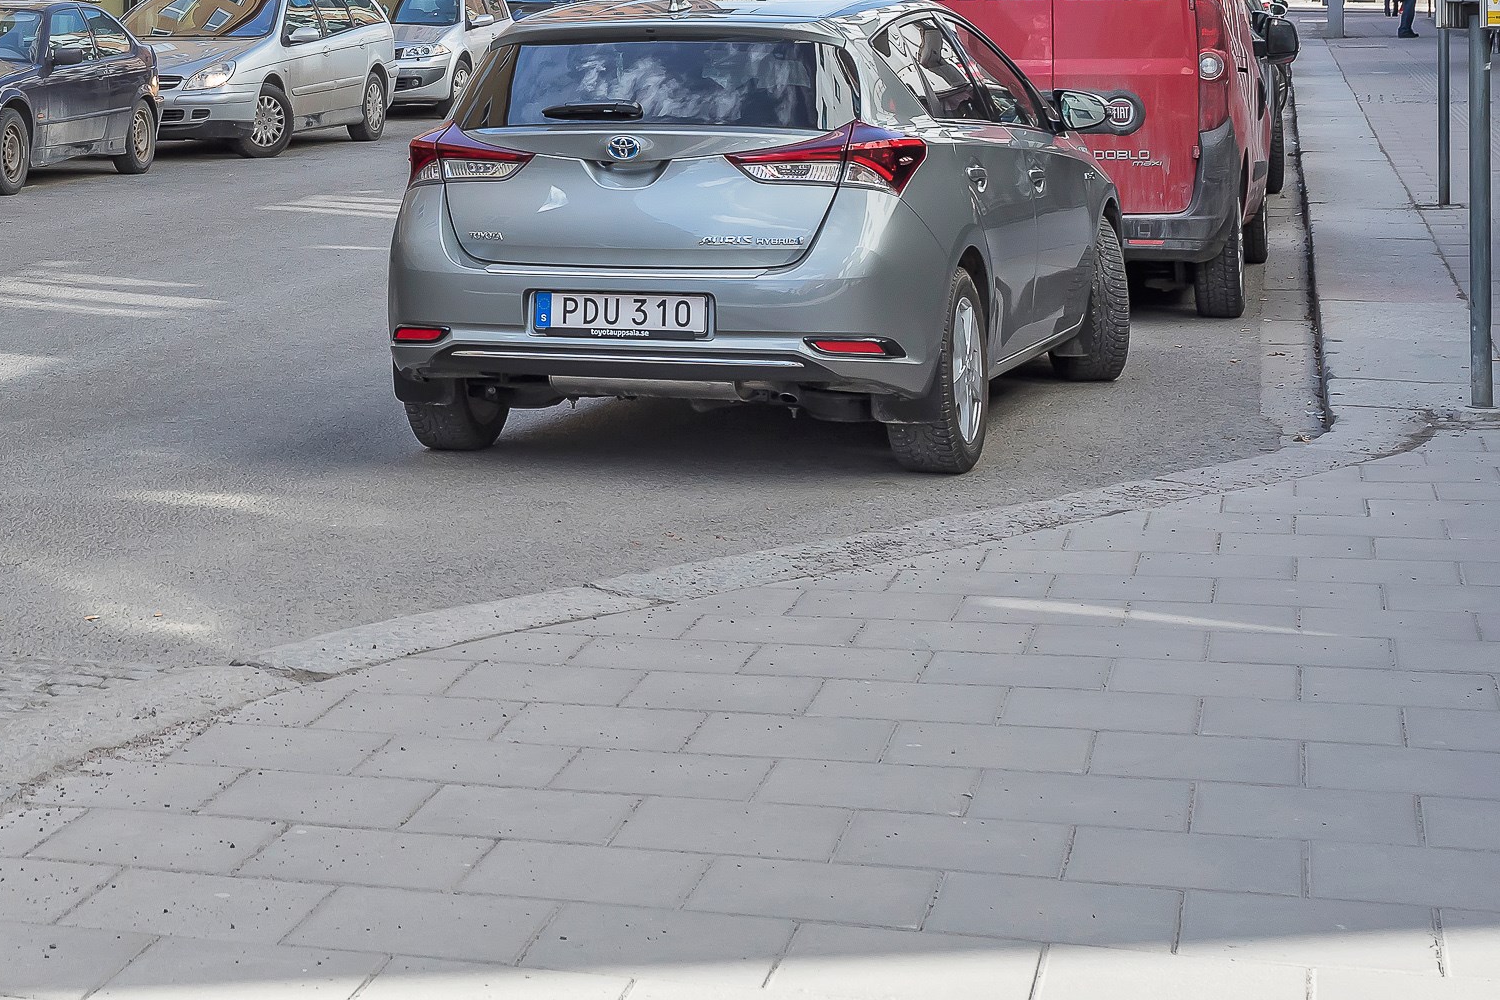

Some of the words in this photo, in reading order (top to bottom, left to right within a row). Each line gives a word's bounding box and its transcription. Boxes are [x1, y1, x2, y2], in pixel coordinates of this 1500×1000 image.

[1113, 106, 1130, 119] FIAT
[1093, 149, 1150, 160] DOBLO
[469, 230, 504, 241] TOYOTA
[562, 297, 620, 325] PDU
[631, 298, 691, 328] 310
[590, 328, 650, 337] toyotauppsala.se
